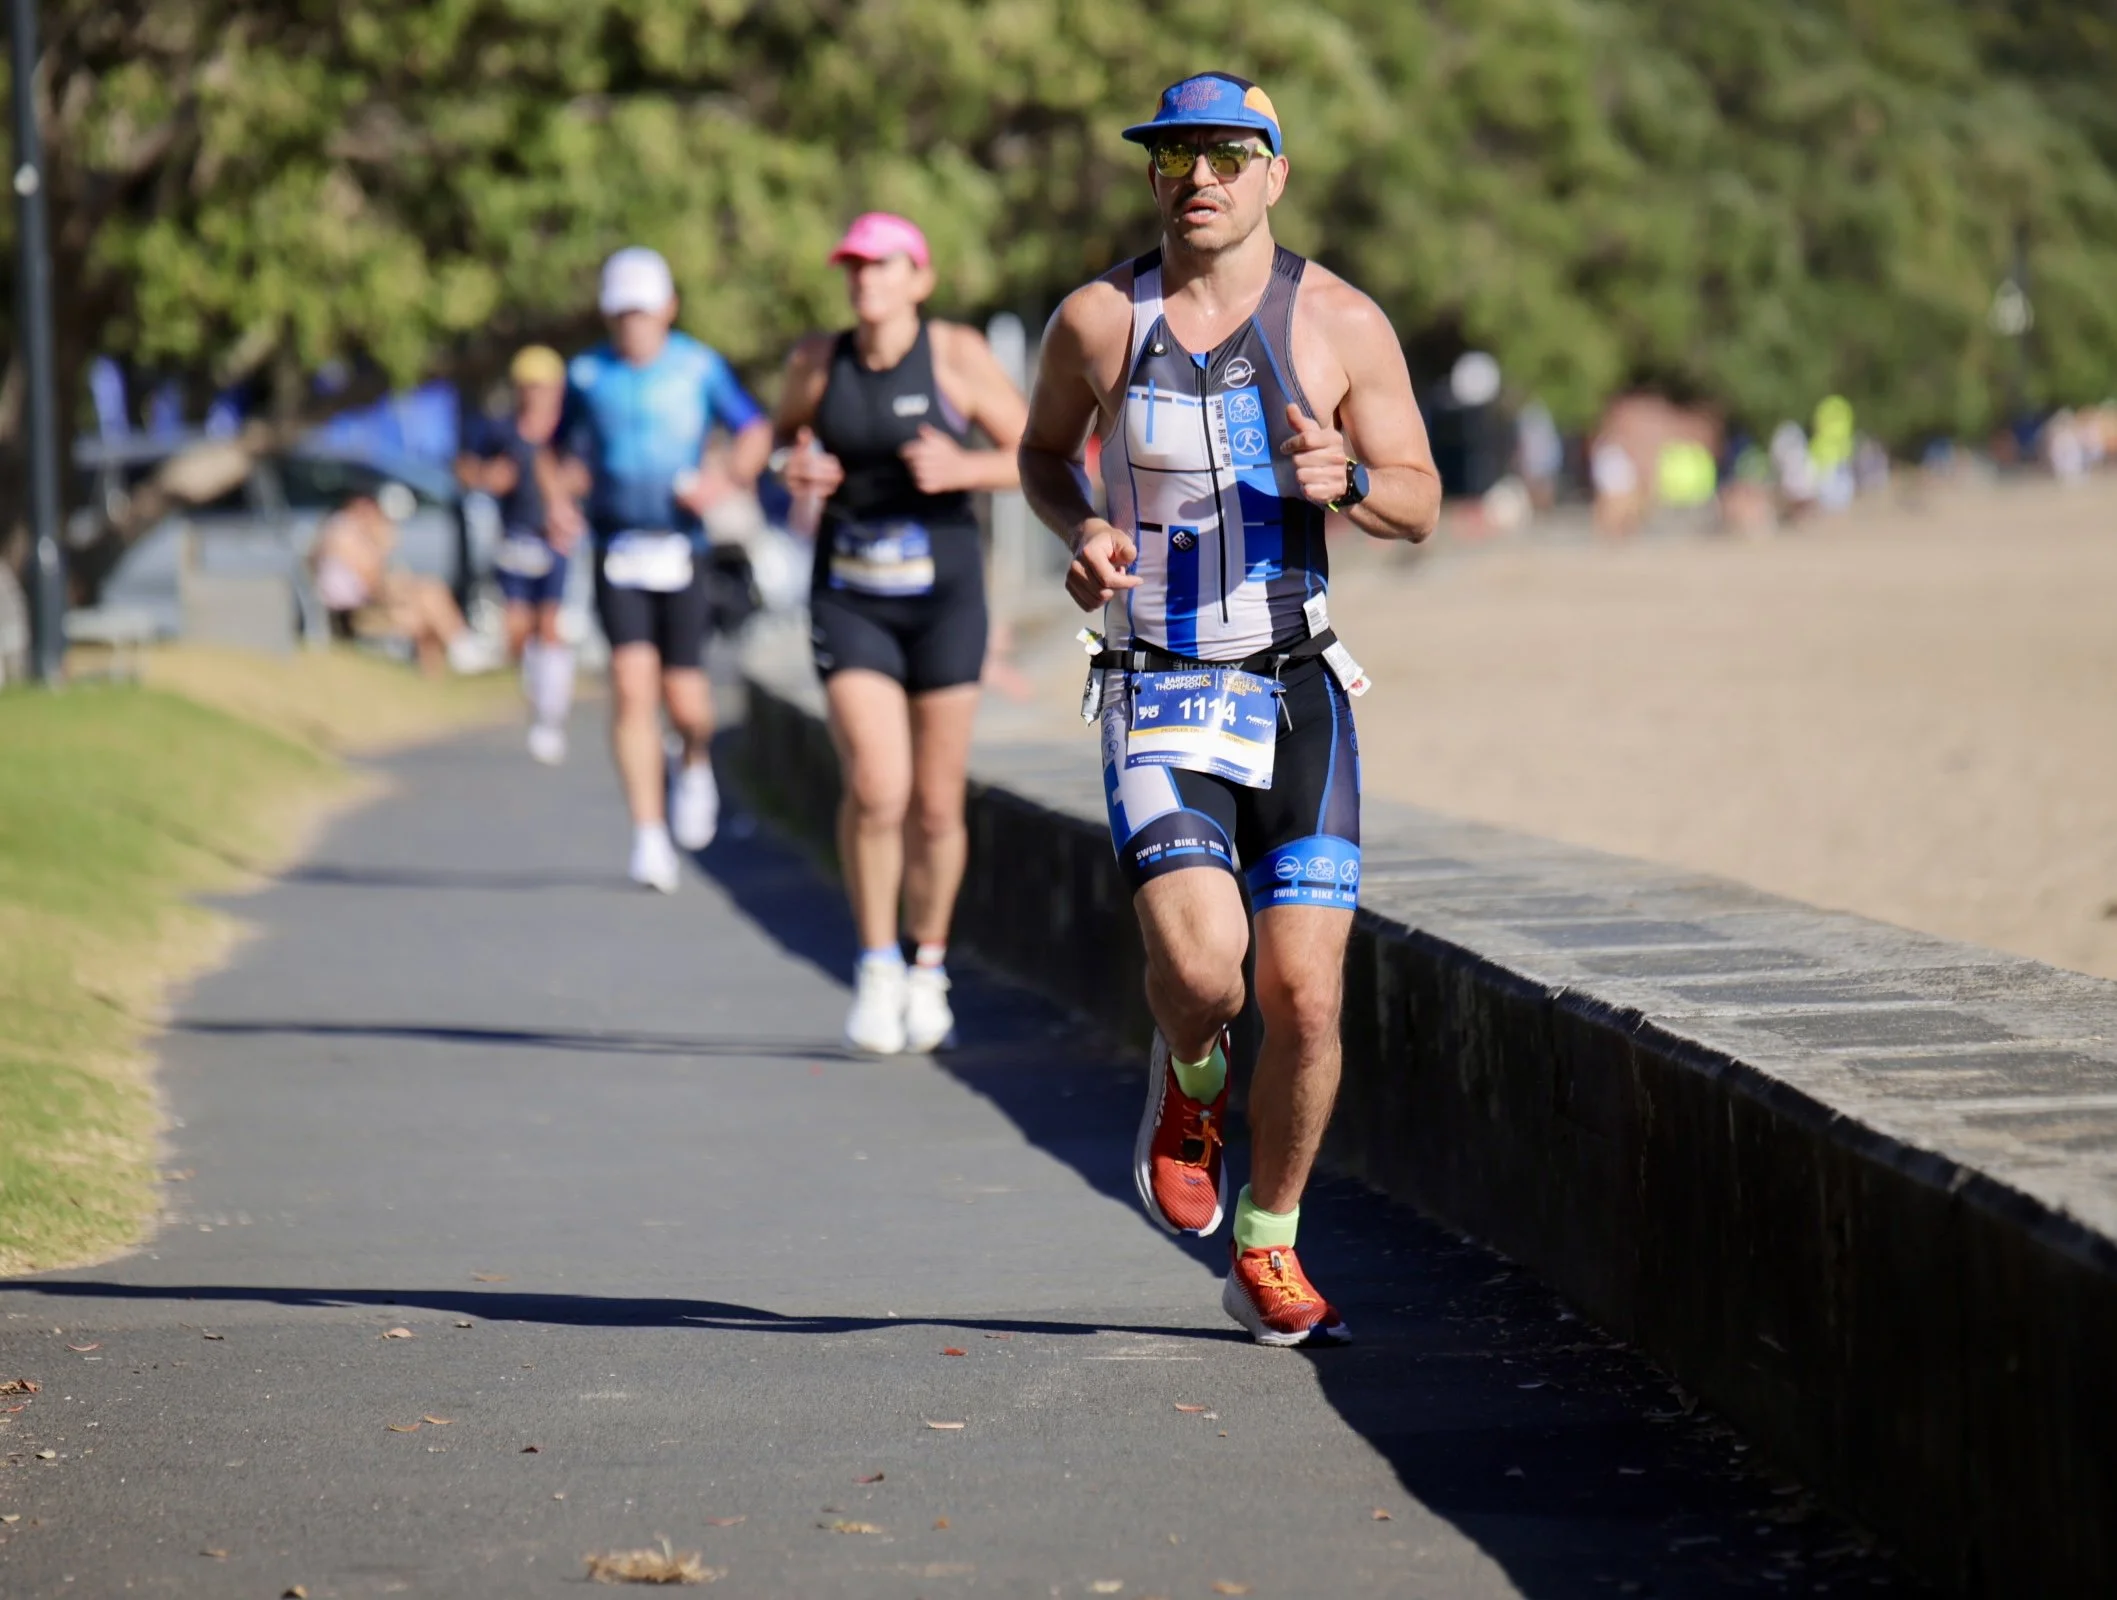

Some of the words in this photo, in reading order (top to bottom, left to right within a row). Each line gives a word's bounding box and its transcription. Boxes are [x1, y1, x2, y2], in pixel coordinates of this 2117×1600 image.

[1214, 399, 1224, 420] SWIM
[1217, 429, 1228, 446] BIKE
[1222, 453, 1231, 468] RUN
[1154, 682, 1201, 691] THOMPSON
[1164, 675, 1201, 685] BARFOOT
[1200, 674, 1212, 688] &
[1179, 697, 1236, 727] 1114
[1135, 843, 1162, 861] SWIM
[1174, 838, 1198, 848] BIKE
[1208, 840, 1225, 854] RUN
[1273, 889, 1299, 898] SWIM
[1311, 889, 1333, 900] BIKE
